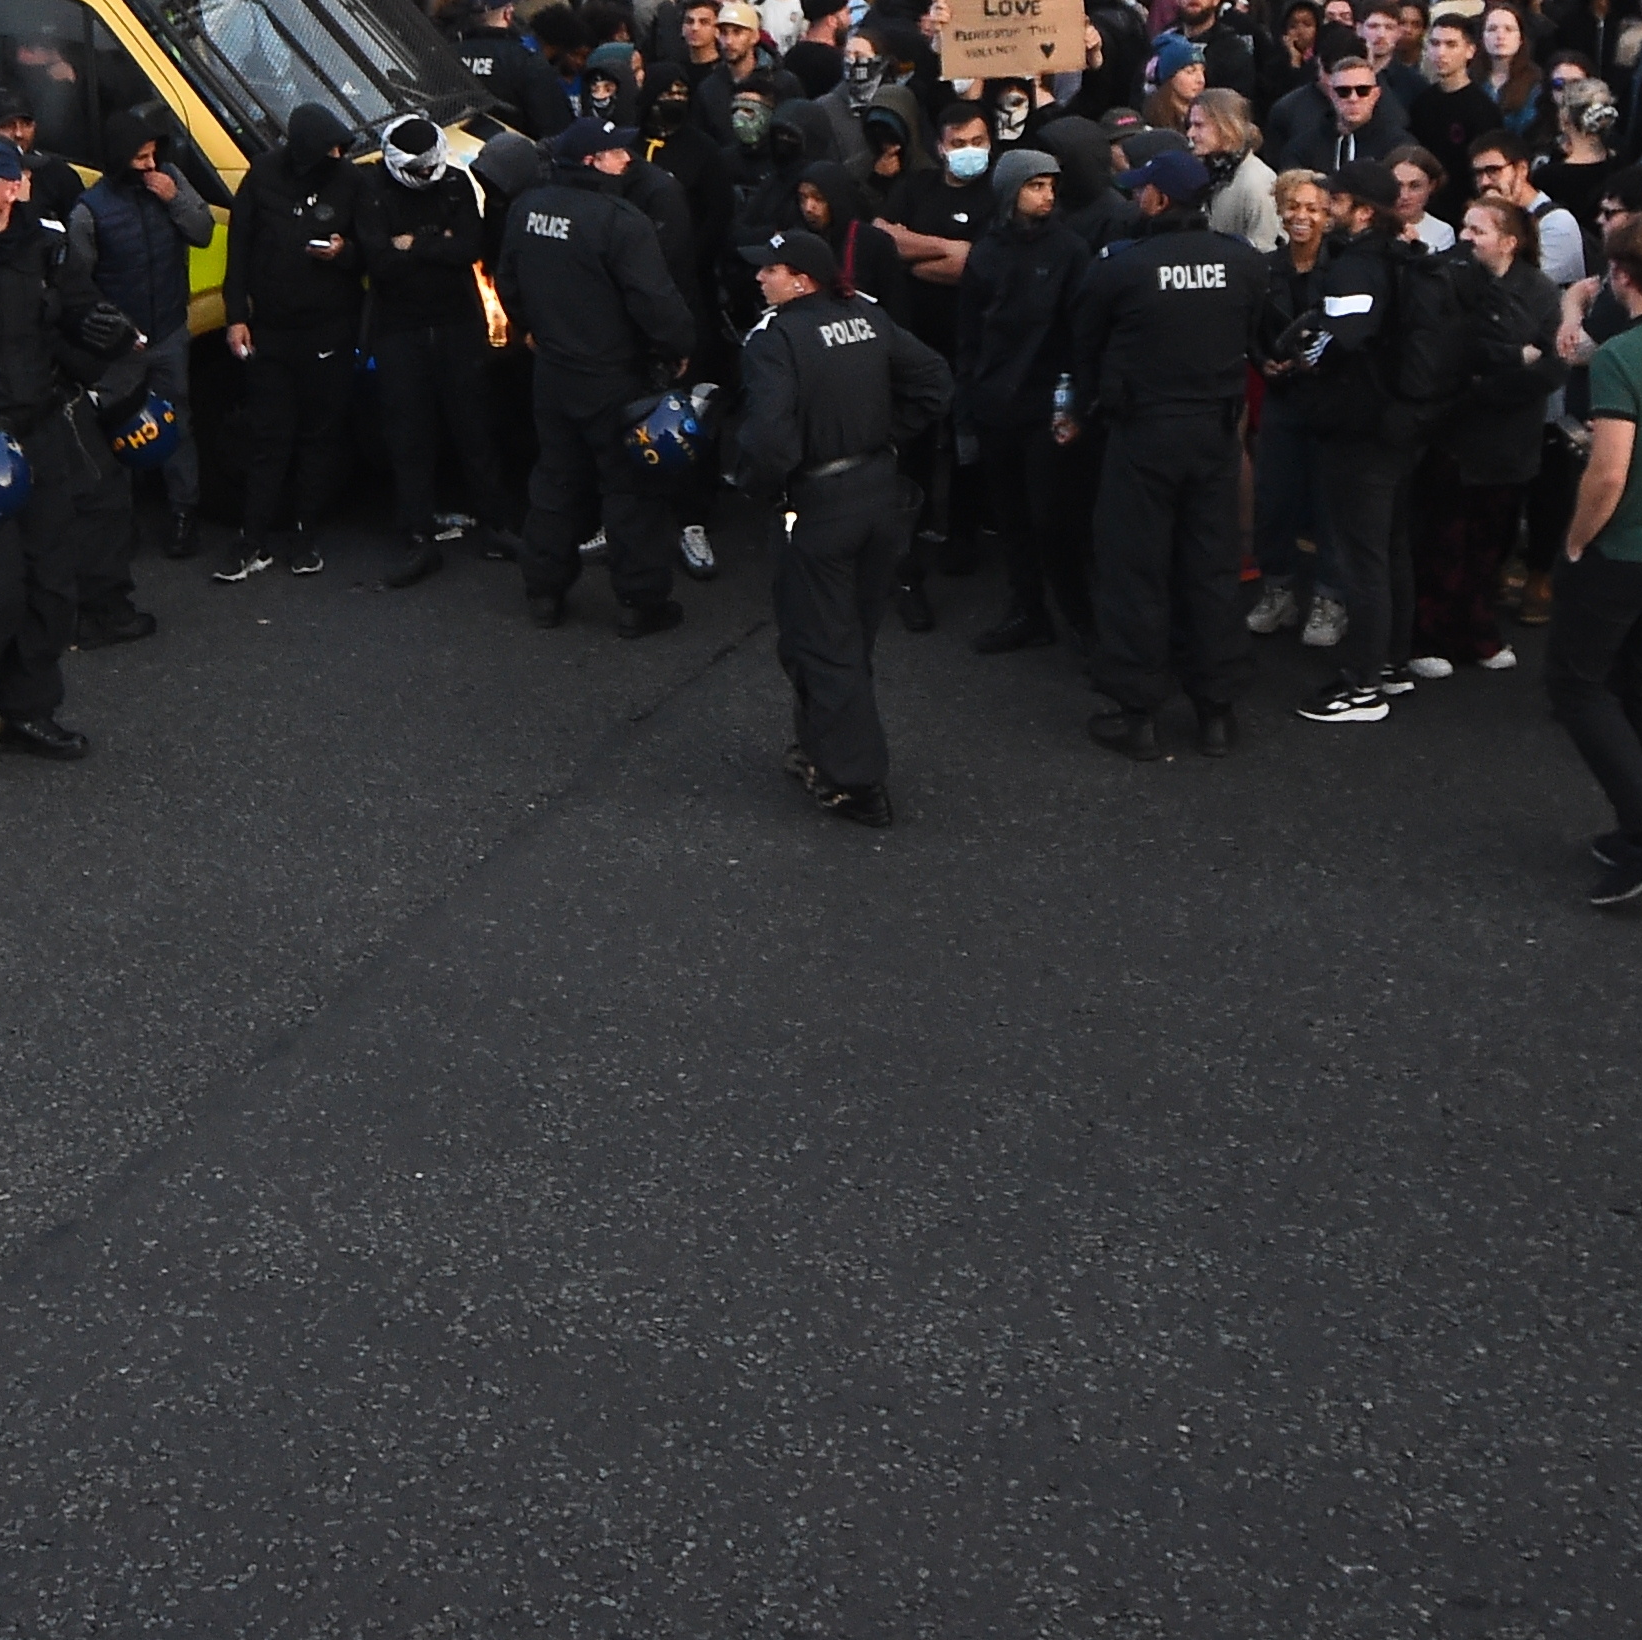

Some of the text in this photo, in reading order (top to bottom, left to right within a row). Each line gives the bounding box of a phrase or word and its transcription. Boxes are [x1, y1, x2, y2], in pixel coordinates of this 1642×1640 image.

[526, 211, 571, 240] POLICE
[1158, 263, 1227, 291] POLICE
[819, 317, 877, 348] POLICE
